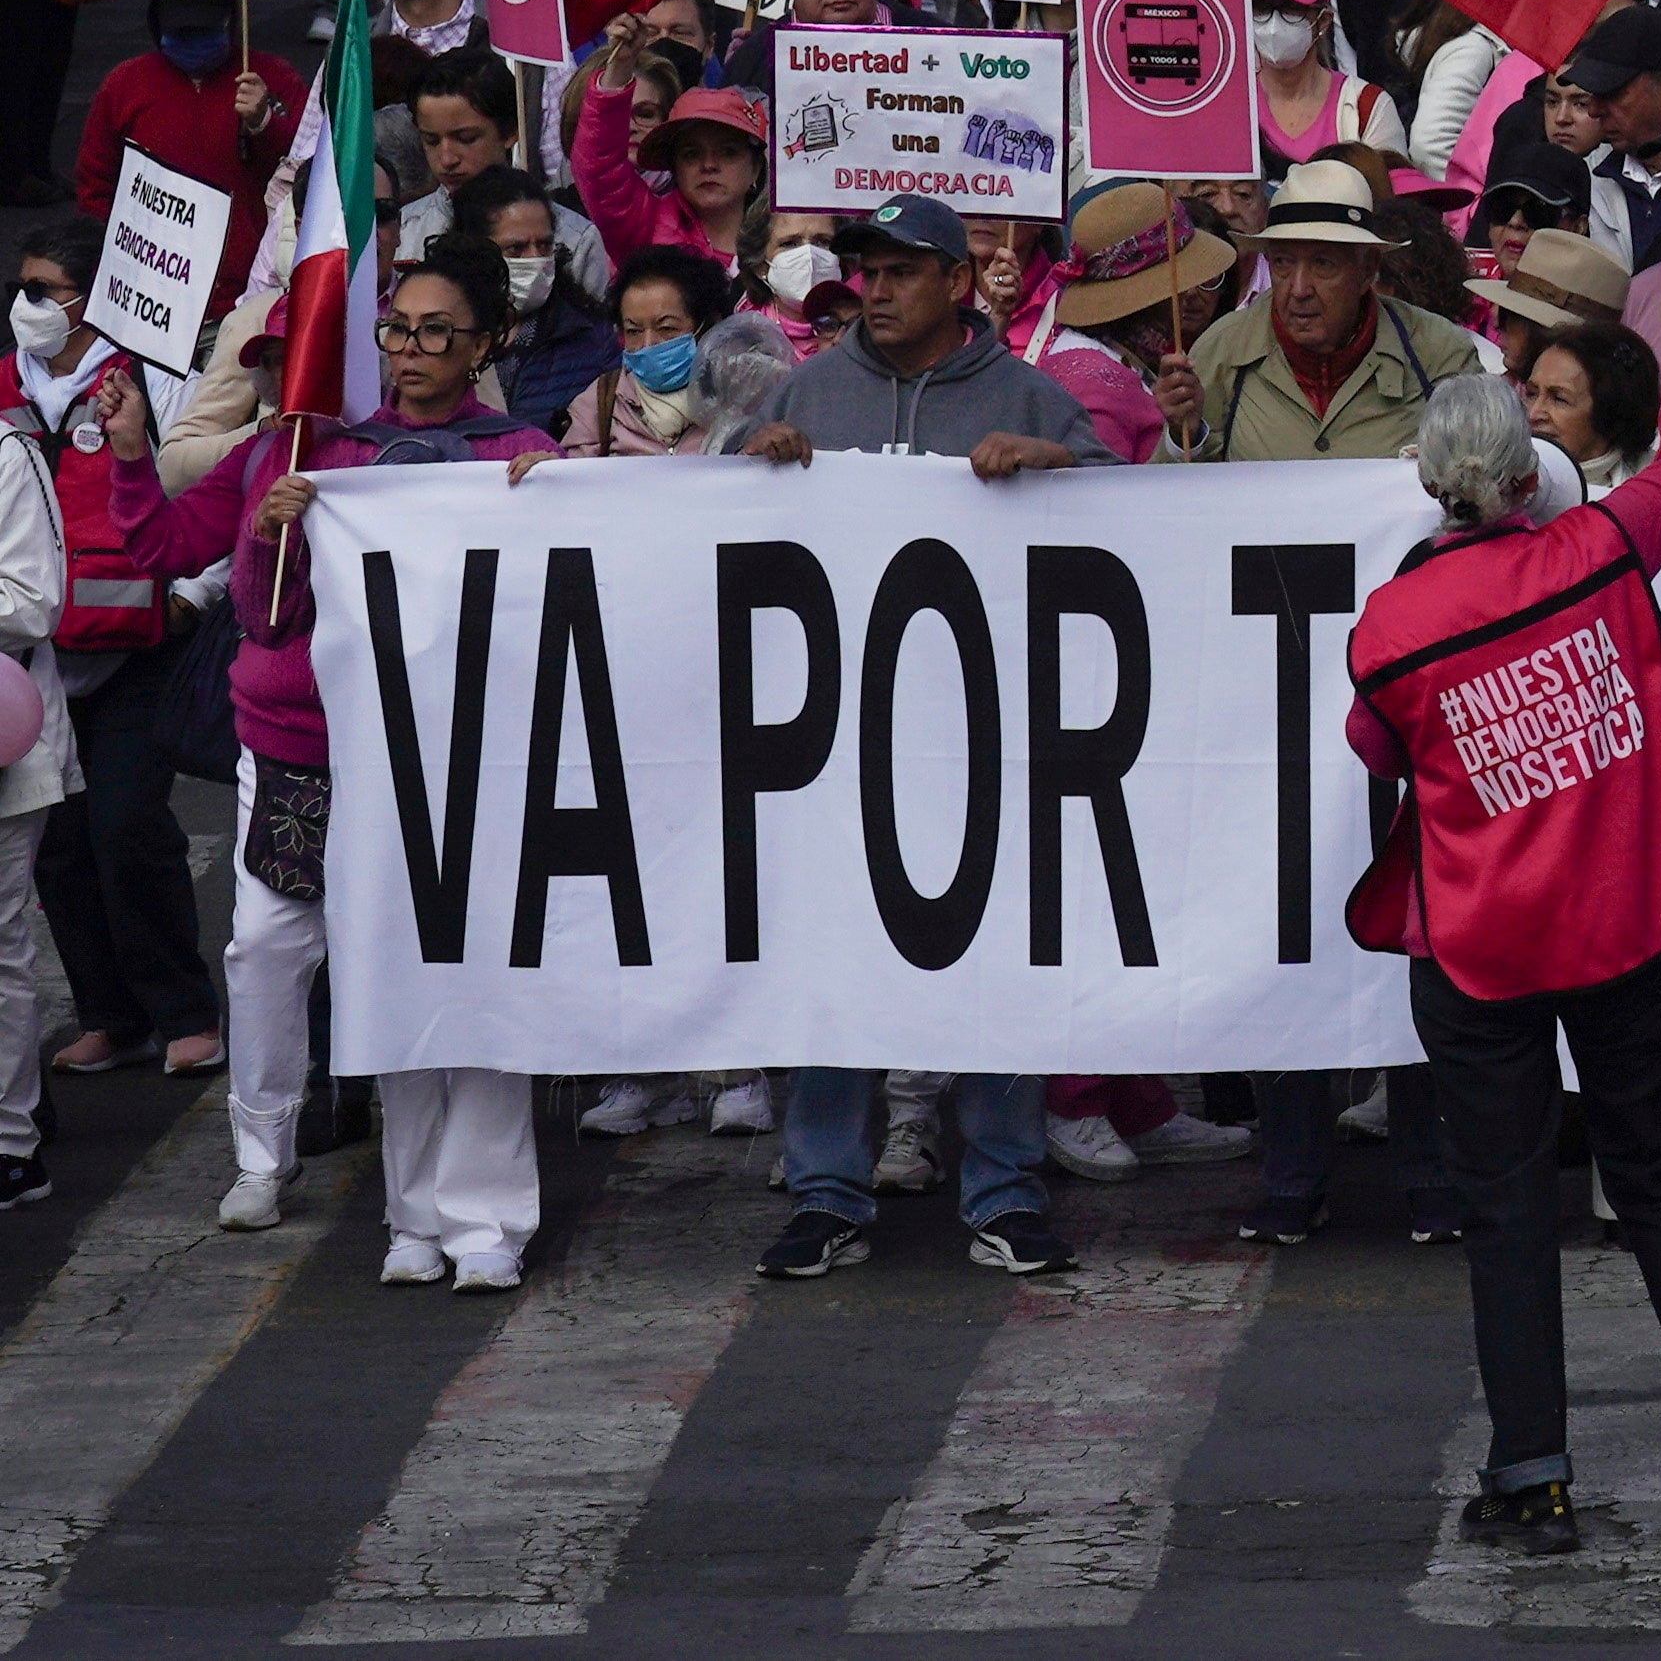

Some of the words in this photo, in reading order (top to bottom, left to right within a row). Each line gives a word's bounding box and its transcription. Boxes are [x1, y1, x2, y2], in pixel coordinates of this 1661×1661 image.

[1144, 7, 1180, 18] MÉXICO
[789, 46, 909, 74] Libertad
[959, 52, 1031, 81] Voto
[1150, 55, 1178, 65] TODOS
[866, 88, 965, 115] Forman
[892, 134, 940, 154] una
[834, 168, 1015, 199] DEMOCRACIA
[115, 220, 192, 286] DEMOCRACIA
[132, 291, 171, 333] TOCA
[1438, 617, 1619, 736] #NUESTRA
[1453, 661, 1635, 774] DEMOCRACIA
[361, 546, 653, 969] VA
[715, 537, 1159, 972] POR
